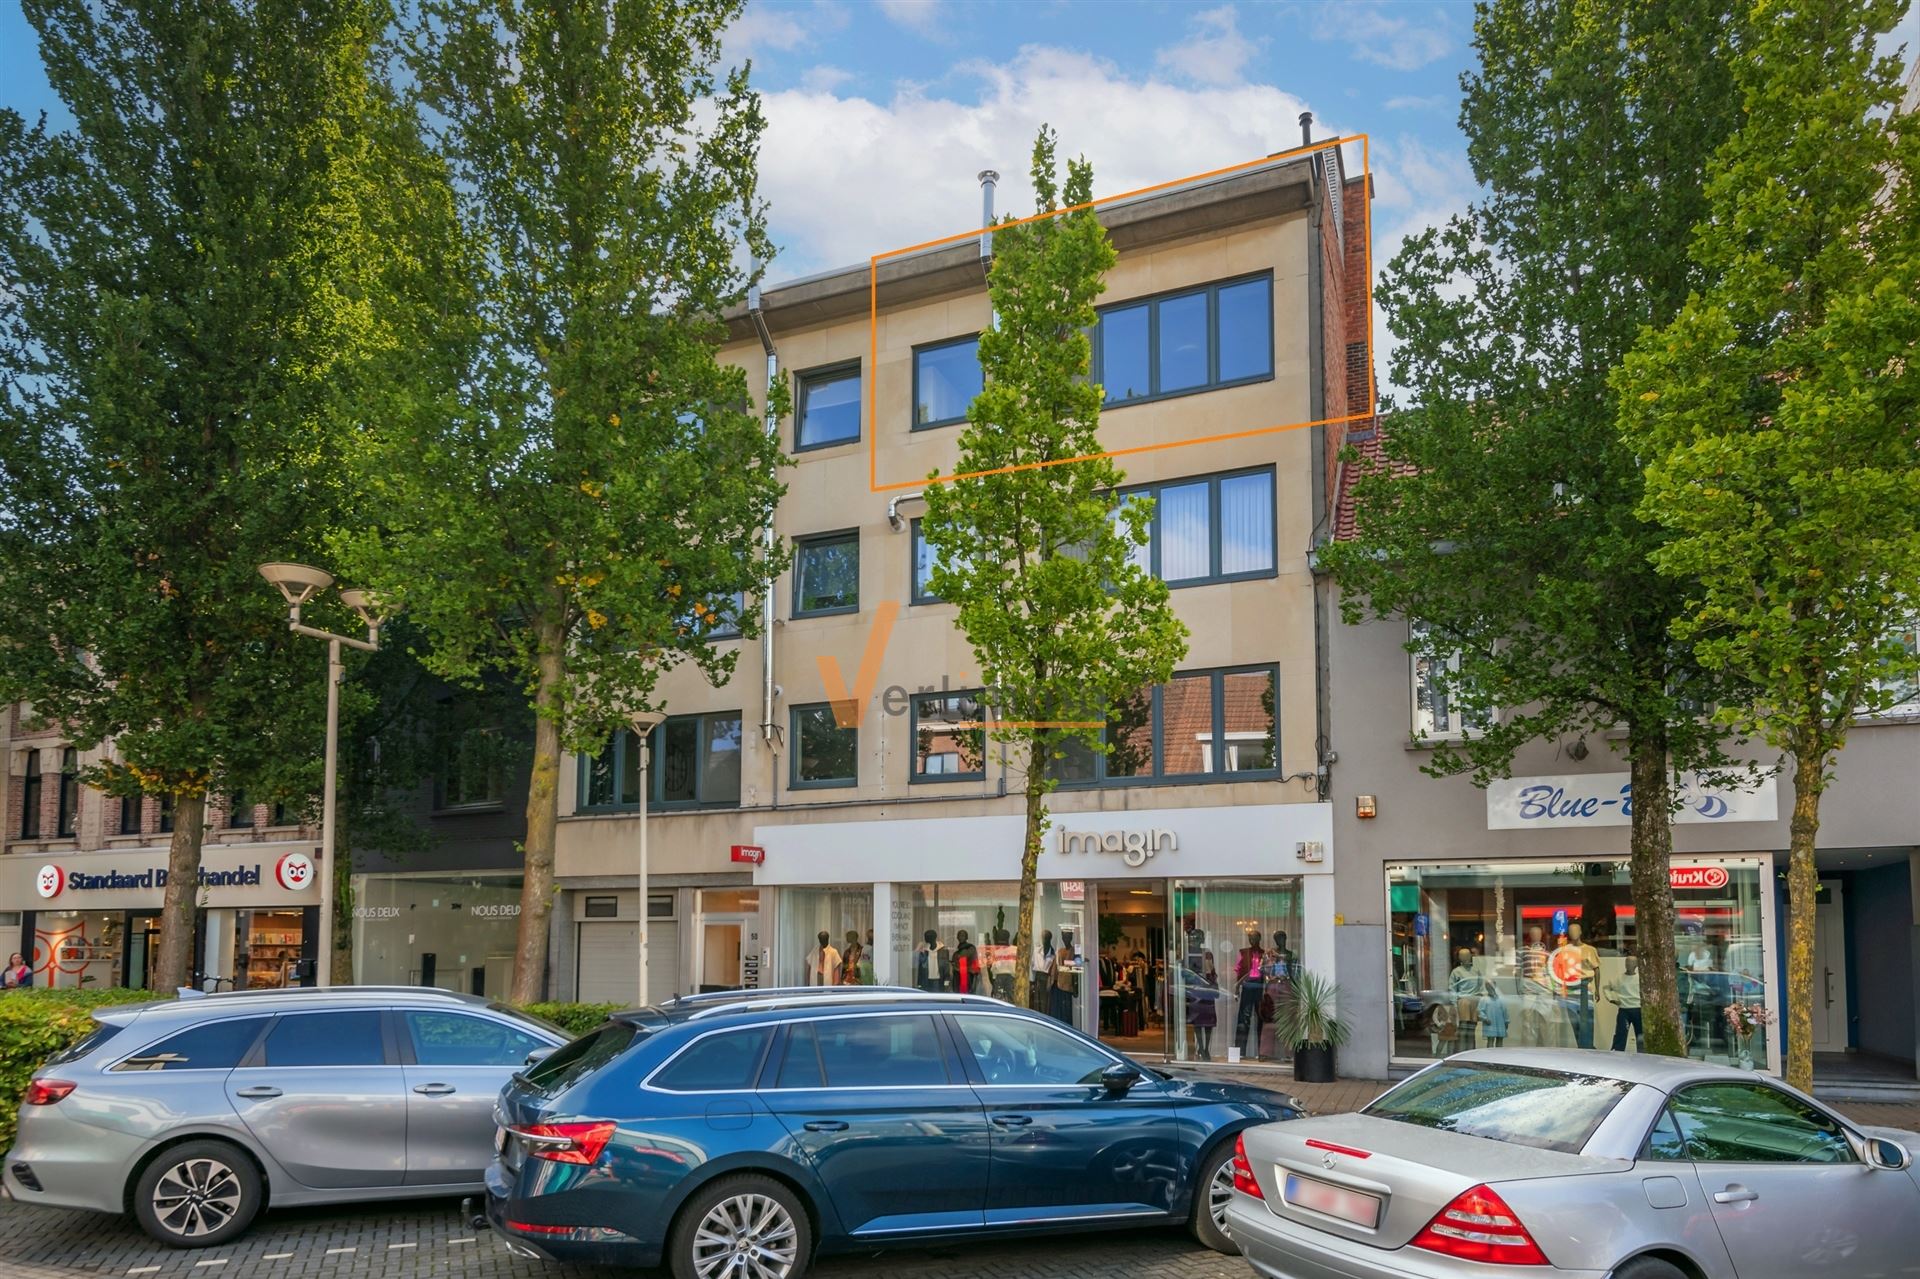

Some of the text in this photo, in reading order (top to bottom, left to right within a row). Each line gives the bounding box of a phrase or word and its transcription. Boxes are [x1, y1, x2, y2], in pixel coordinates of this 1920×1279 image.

[1057, 824, 1179, 868] imagin
[68, 864, 261, 890] Standaard Bhandel
[352, 906, 400, 918] NOUS DEUX
[471, 905, 498, 917] NOUS
